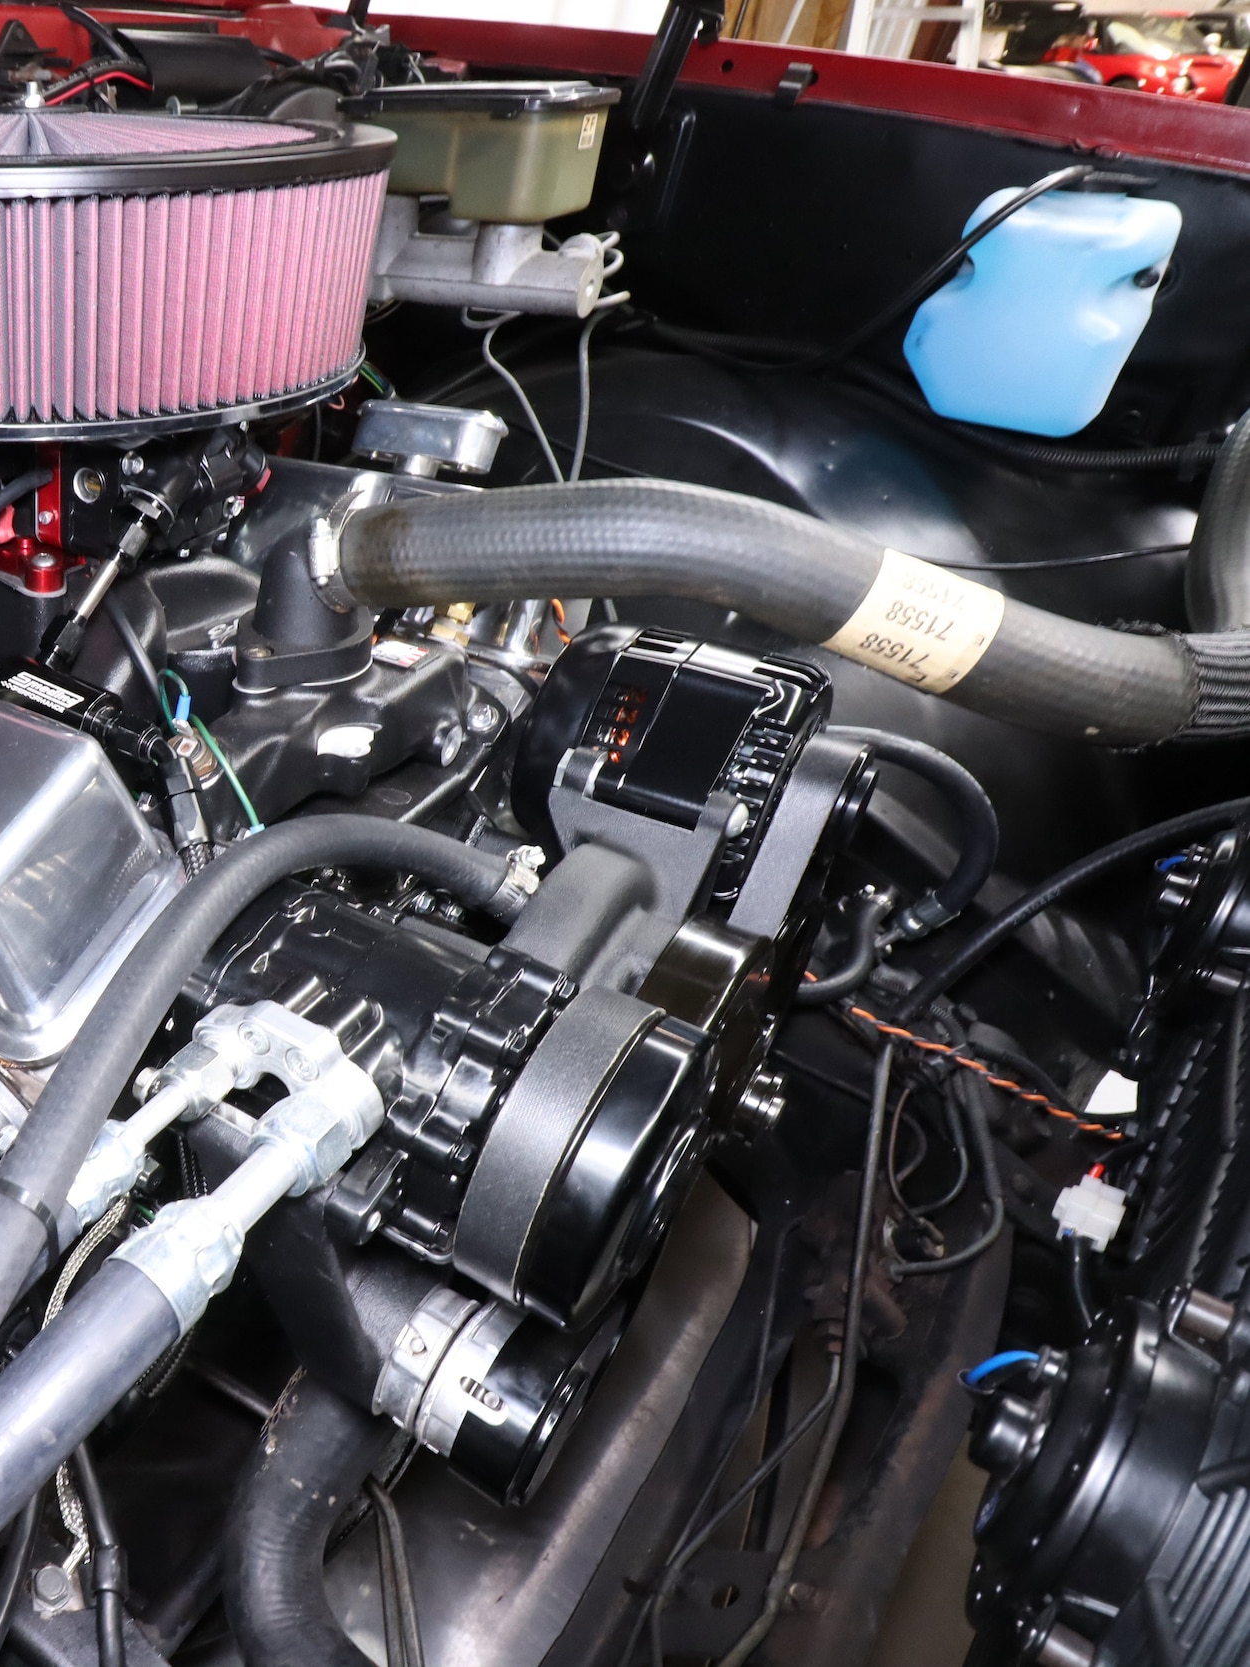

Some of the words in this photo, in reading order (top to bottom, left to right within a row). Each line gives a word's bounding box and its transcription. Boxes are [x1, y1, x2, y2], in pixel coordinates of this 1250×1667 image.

[885, 600, 955, 641] 71558
[859, 632, 930, 670] 71558
[13, 685, 66, 714] PERFORMANCE
